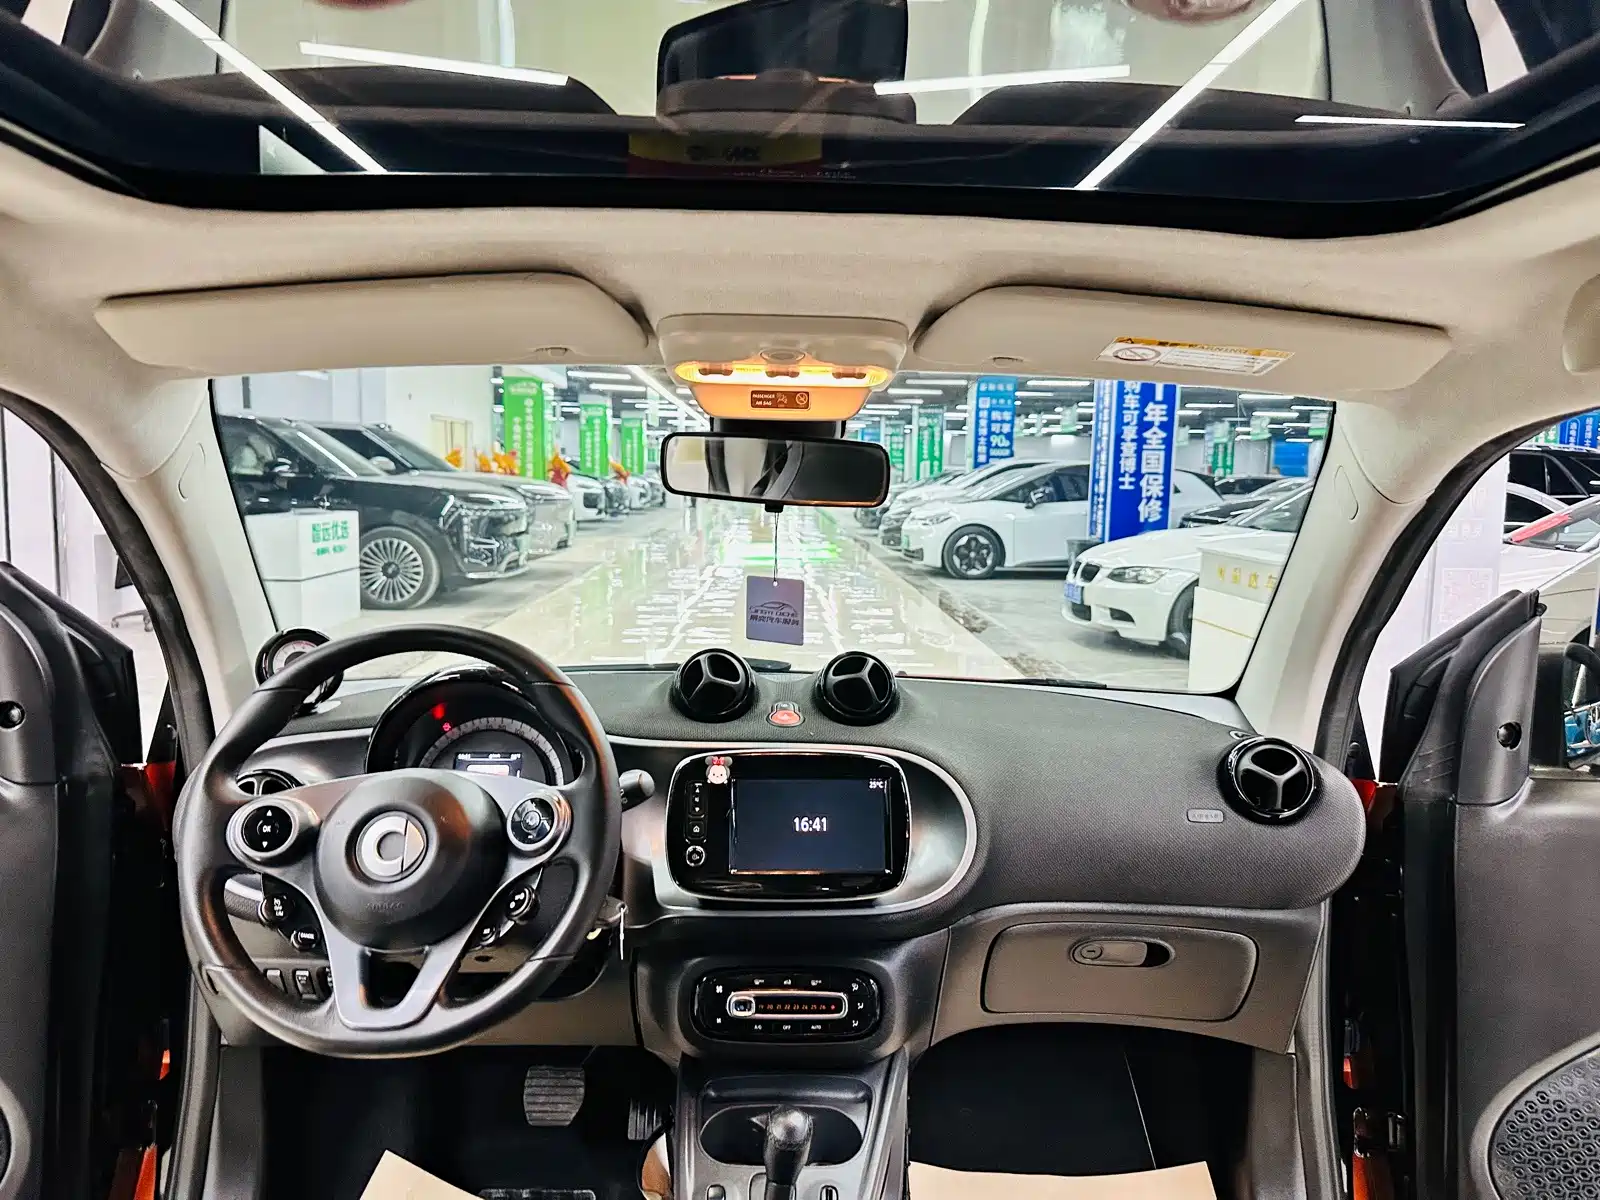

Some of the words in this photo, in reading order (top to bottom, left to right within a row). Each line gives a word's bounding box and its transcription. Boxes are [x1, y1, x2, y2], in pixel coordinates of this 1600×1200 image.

[1188, 343, 1249, 354] WARNING
[793, 816, 827, 832] 16:41
[262, 825, 272, 833] OK
[300, 932, 314, 940] CANCEL
